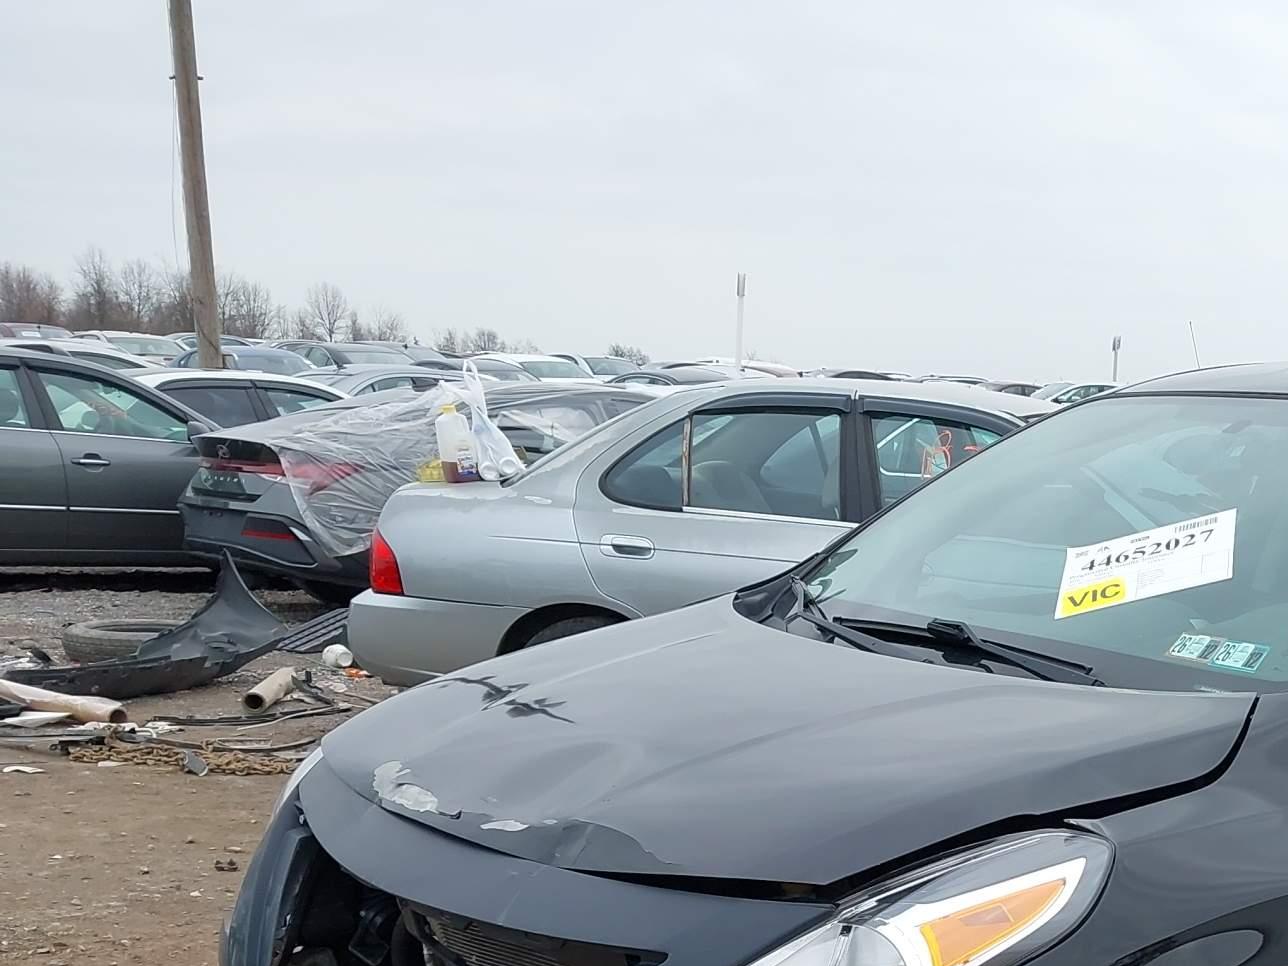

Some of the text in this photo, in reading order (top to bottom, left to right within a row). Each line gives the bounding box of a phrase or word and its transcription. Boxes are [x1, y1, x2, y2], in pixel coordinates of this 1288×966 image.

[1081, 528, 1215, 571] 44652027
[1067, 583, 1121, 607] VIC
[1172, 635, 1193, 654] 26
[1216, 643, 1237, 662] 26
